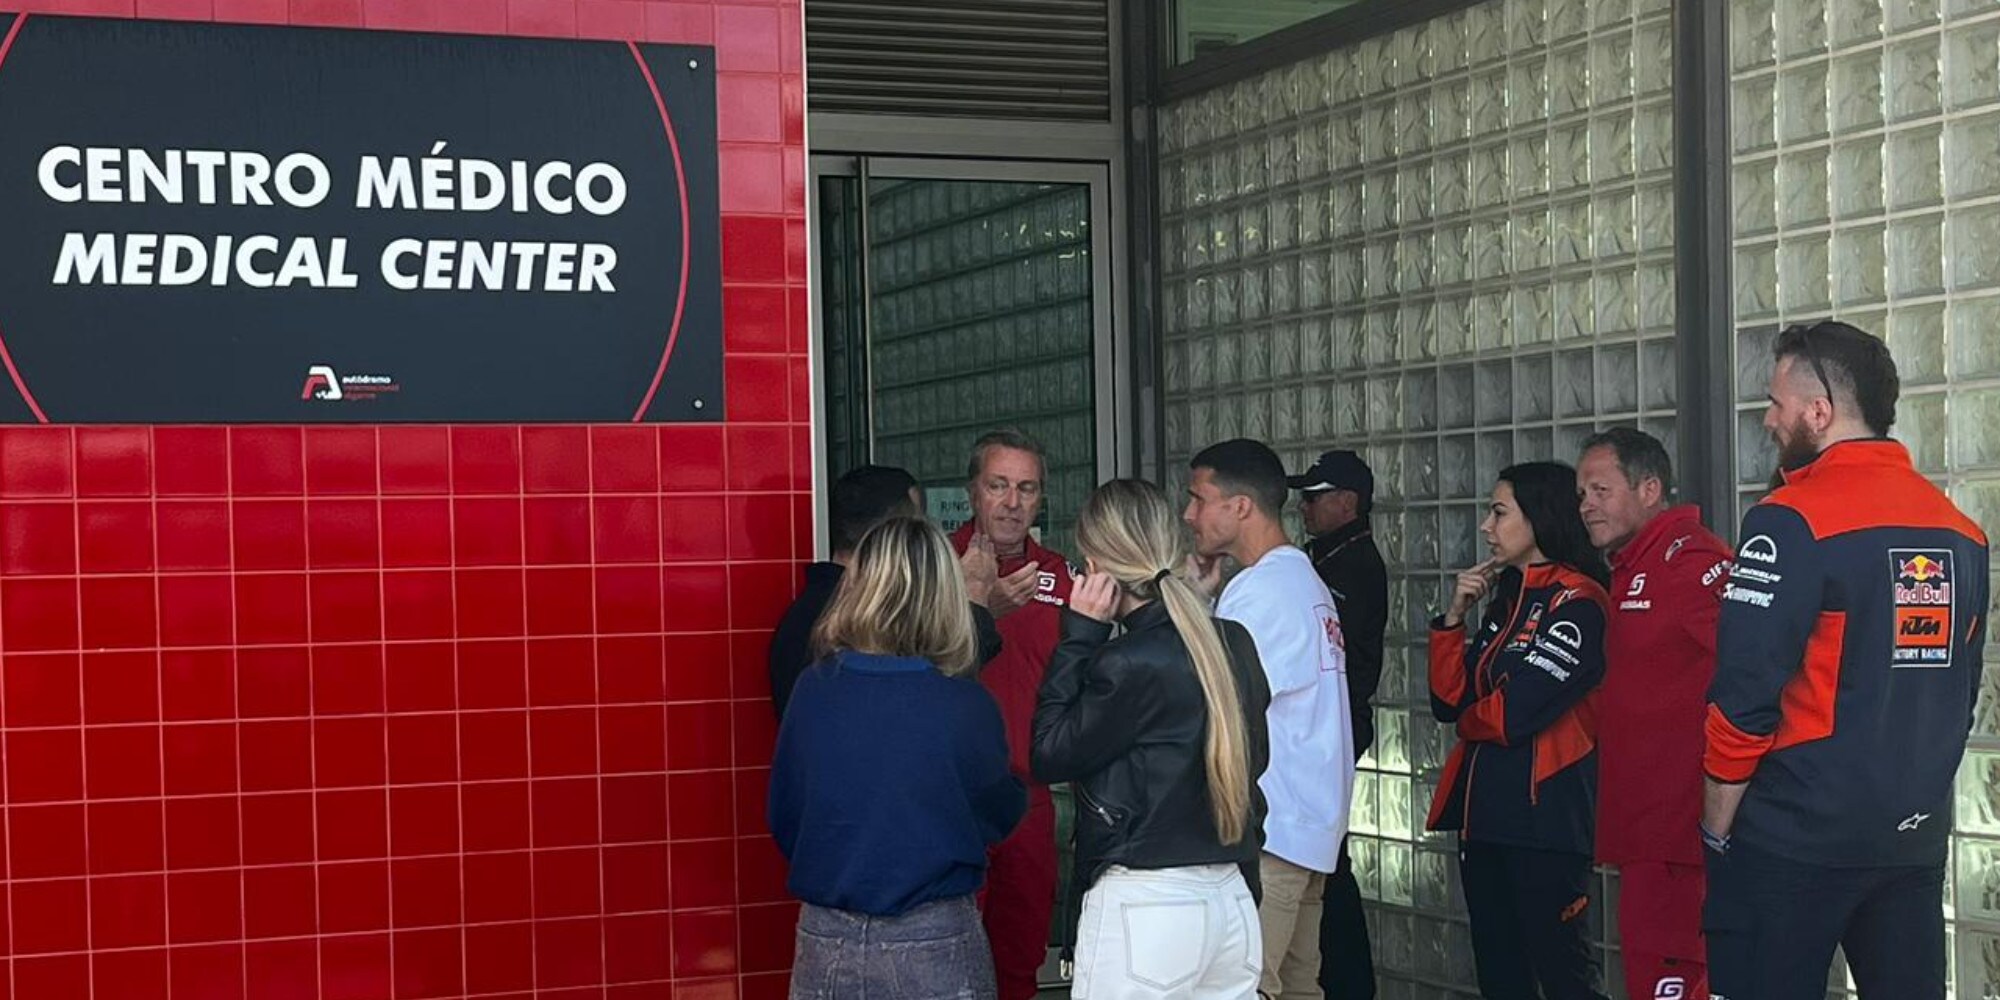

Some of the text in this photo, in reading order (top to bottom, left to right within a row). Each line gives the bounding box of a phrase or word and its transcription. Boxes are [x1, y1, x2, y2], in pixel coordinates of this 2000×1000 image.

[37, 140, 627, 216] CENTRO MÉDICO
[52, 232, 617, 293] MEDICAL CENTER
[941, 501, 970, 511] RING
[1894, 583, 1950, 604] Red Bull
[1900, 615, 1941, 635] KTM
